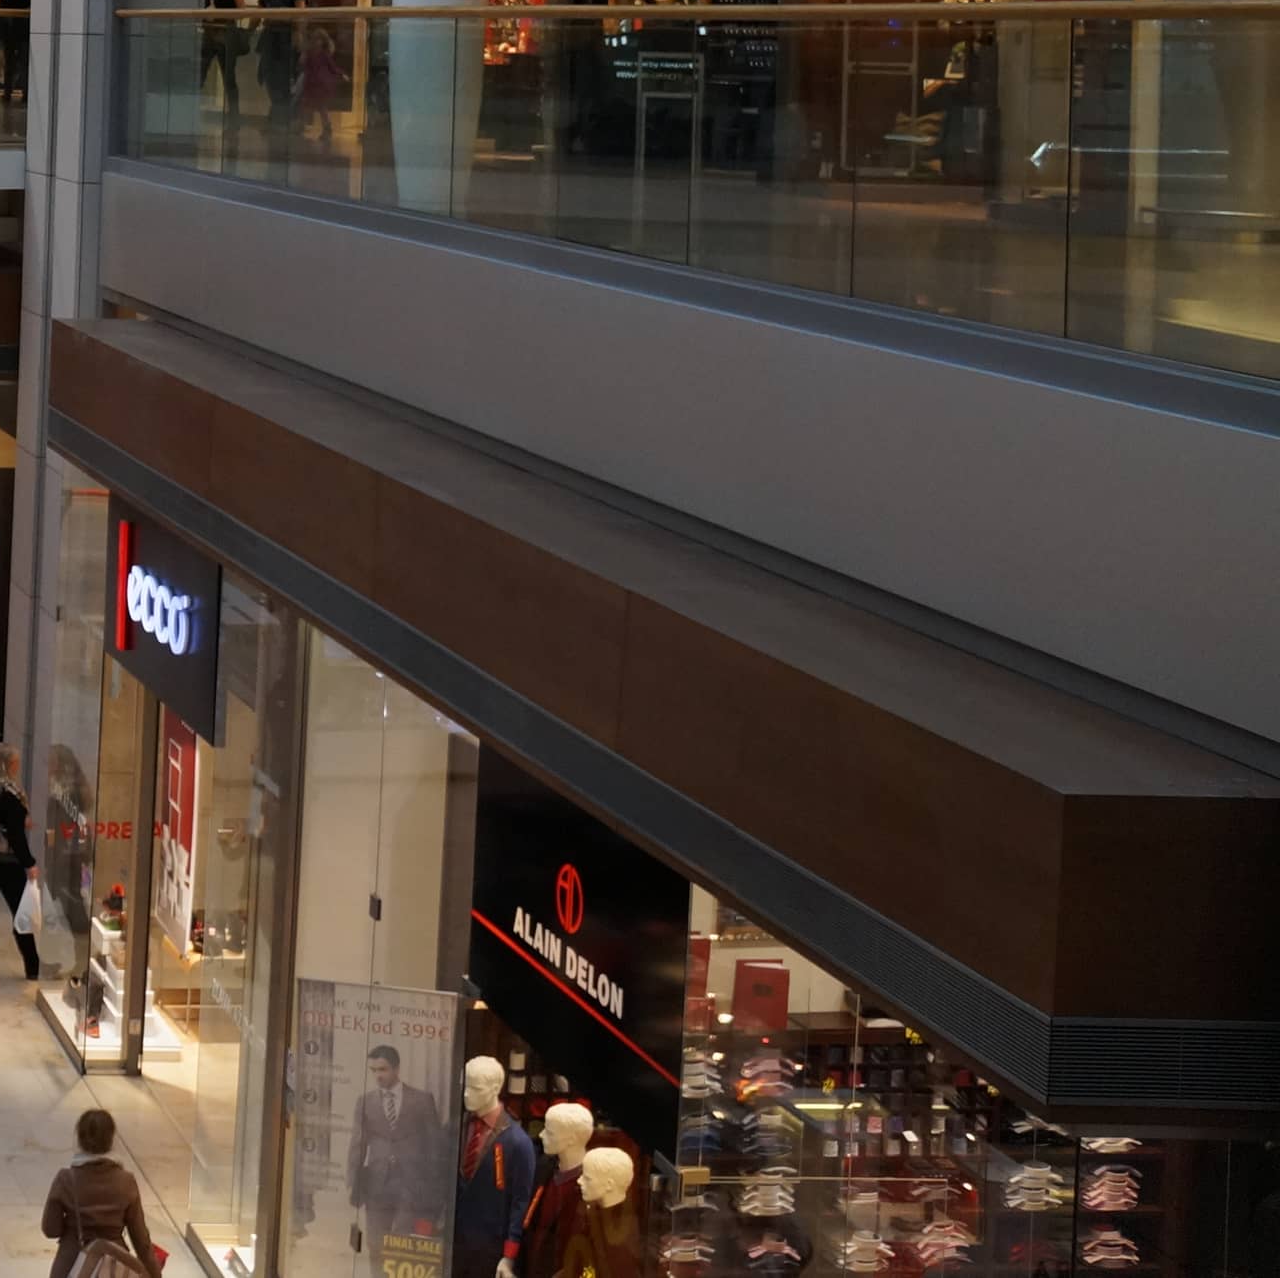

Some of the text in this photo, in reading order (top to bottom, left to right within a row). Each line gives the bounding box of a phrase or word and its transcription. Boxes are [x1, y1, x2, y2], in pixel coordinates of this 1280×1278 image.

[126, 564, 191, 655] ecco
[513, 906, 624, 1020] ALAIN DELON
[371, 1020, 393, 1035] od
